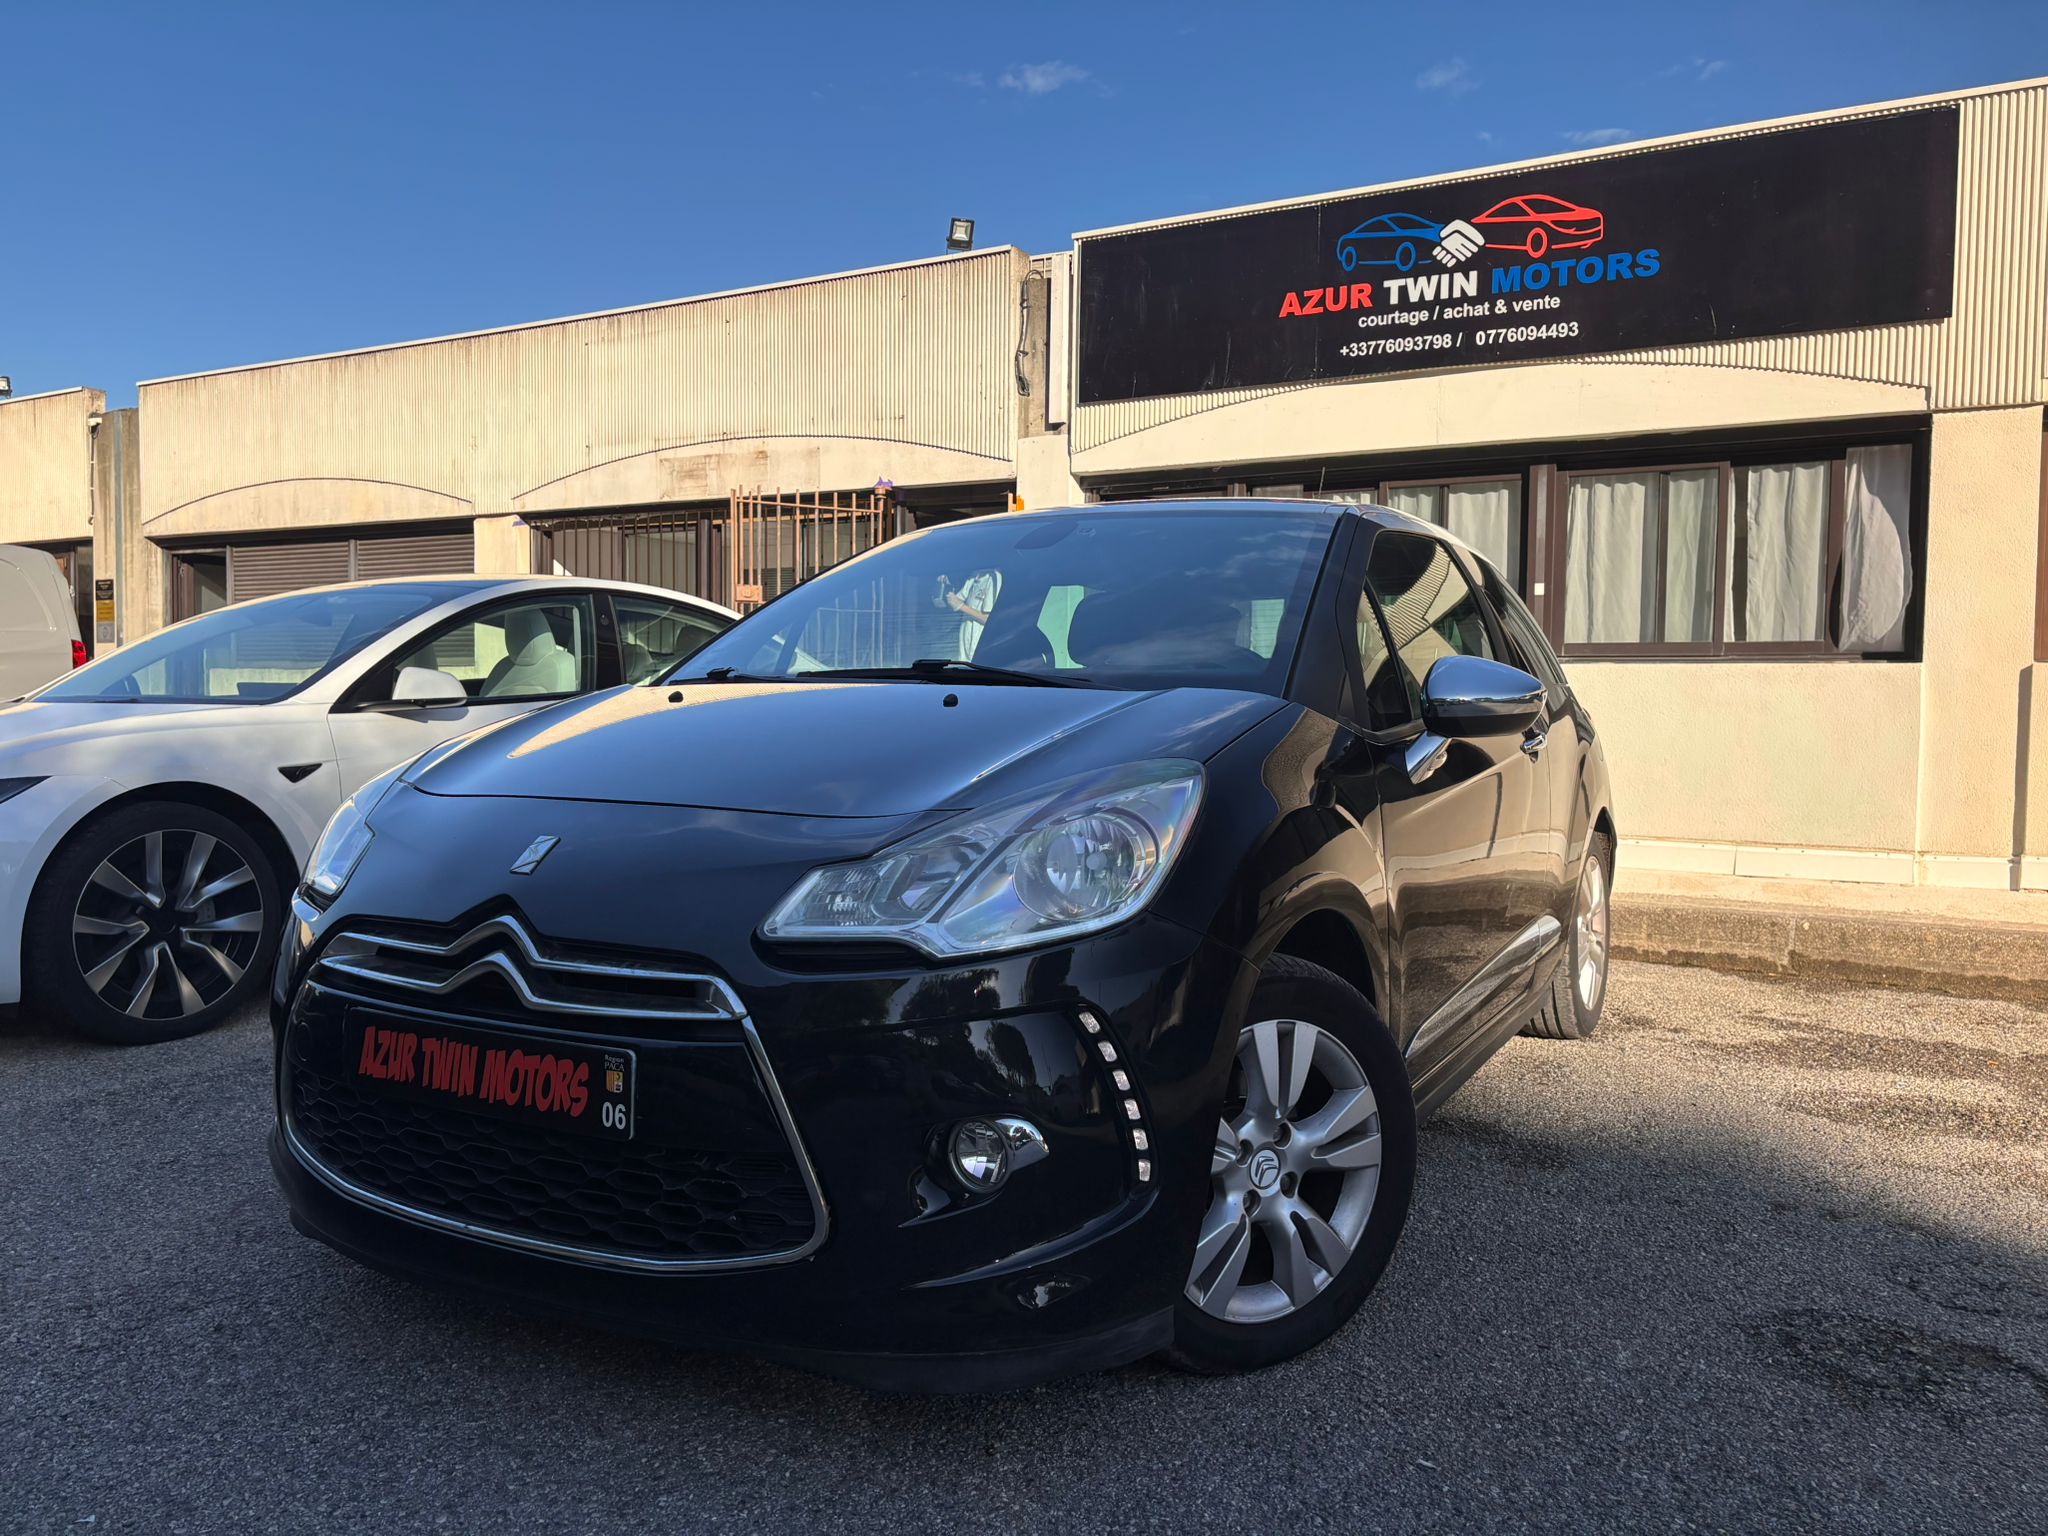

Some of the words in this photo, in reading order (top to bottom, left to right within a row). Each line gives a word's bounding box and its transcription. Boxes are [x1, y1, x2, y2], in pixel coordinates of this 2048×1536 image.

[1278, 282, 1373, 318] AZUR
[1384, 270, 1478, 305] TWIN
[1492, 248, 1661, 294] MOTORS
[1358, 309, 1429, 328] courtage
[1443, 302, 1490, 319] achat
[1495, 299, 1507, 315] &
[1513, 294, 1561, 312] vente
[1339, 333, 1452, 358] +33776093798
[1475, 322, 1579, 346] 0776094493
[358, 1025, 417, 1083] AZUR
[422, 1037, 478, 1097] TWIN
[480, 1049, 590, 1118] MOTORS
[604, 1061, 625, 1072] PACA
[602, 1101, 626, 1130] 06
